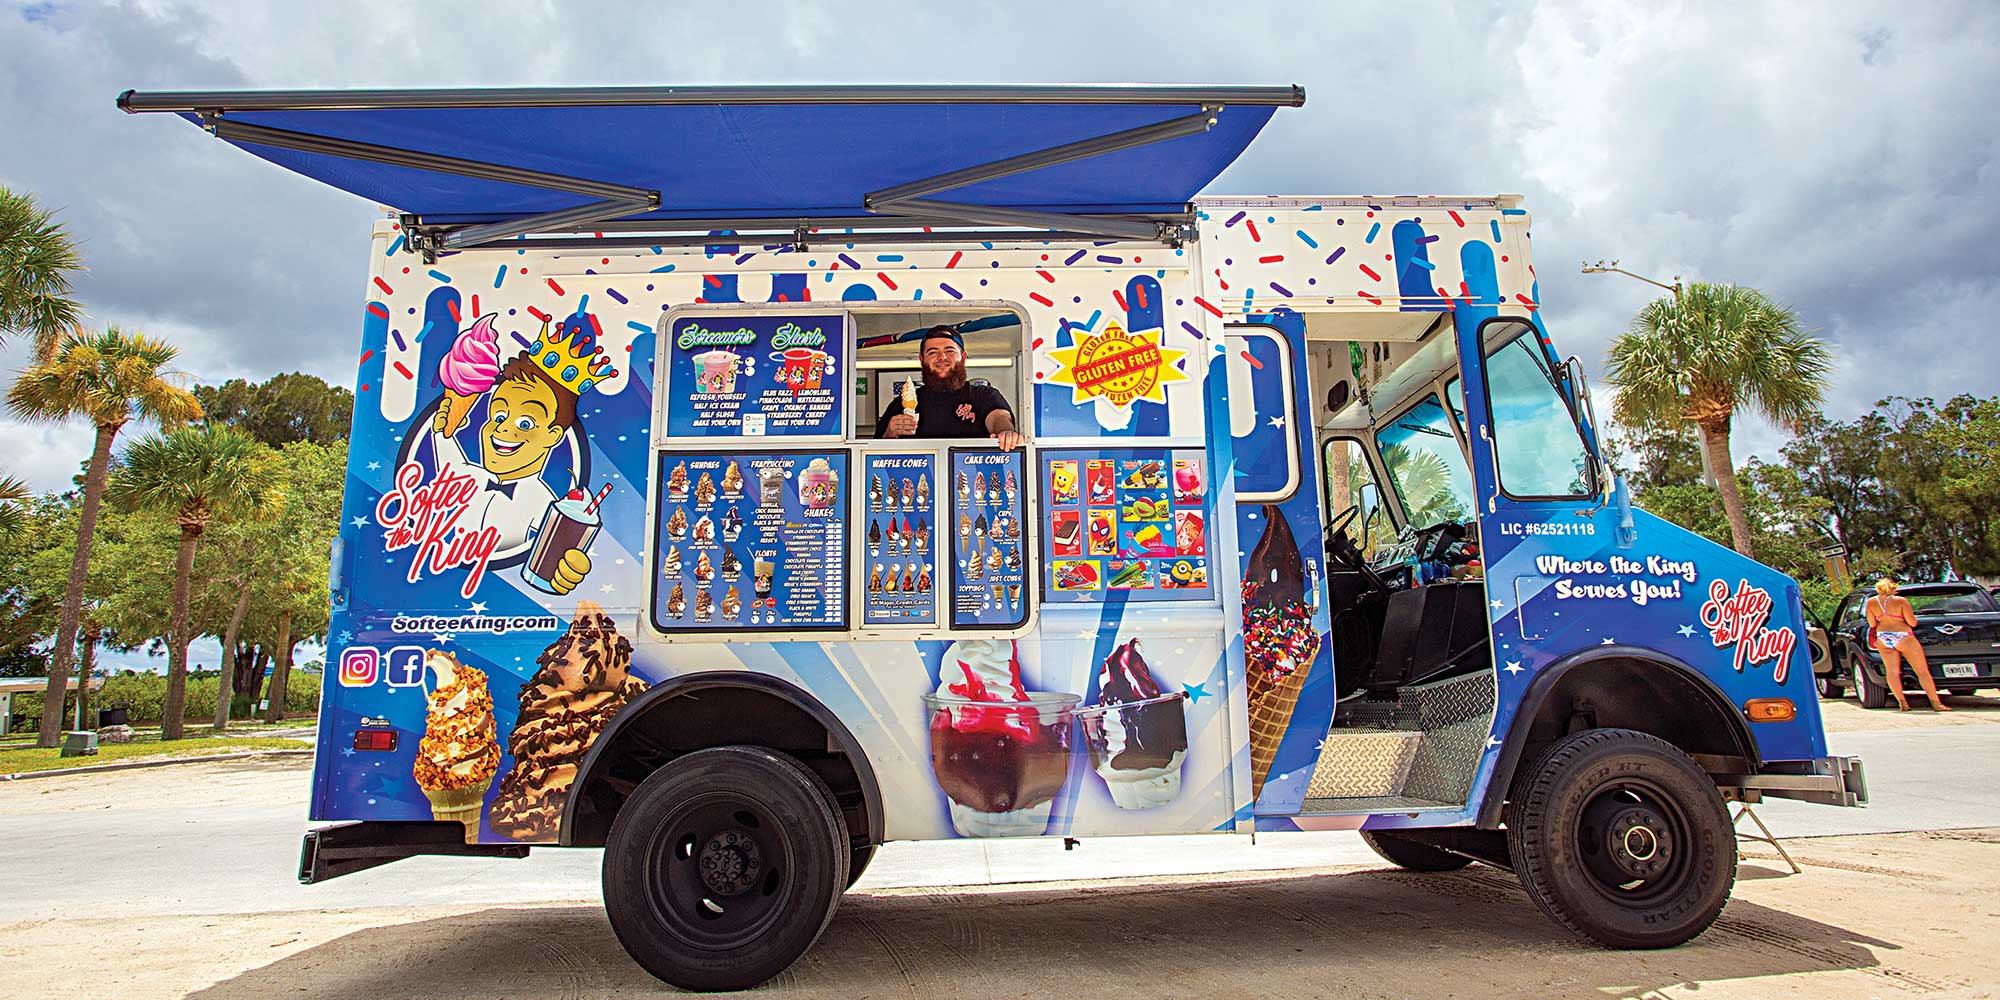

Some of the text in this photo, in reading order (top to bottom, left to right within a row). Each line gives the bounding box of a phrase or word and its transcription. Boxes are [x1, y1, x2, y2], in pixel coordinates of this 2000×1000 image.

[679, 325, 753, 349] Screamers
[772, 324, 825, 349] Slush
[1083, 332, 1134, 356] GLUTEN FREE
[1077, 350, 1158, 383] GLUTEN FREE
[690, 461, 720, 469] SUNDAES
[751, 460, 795, 468] FRAPPUCCINO
[872, 458, 928, 468] WAFFLE CONES
[964, 456, 1010, 464] CAKE CONES
[378, 462, 479, 541] Softee
[804, 508, 834, 518] SHAKES
[387, 523, 412, 549] the
[1501, 522, 1595, 536] LIC #62521118
[410, 505, 502, 596] King
[1536, 556, 1698, 582] Where the King
[1556, 580, 1681, 606] Serves You!
[1702, 581, 1770, 636] Softee
[393, 616, 558, 632] SofteeKing.com
[1713, 627, 1730, 644] the
[1734, 613, 1796, 681] King
